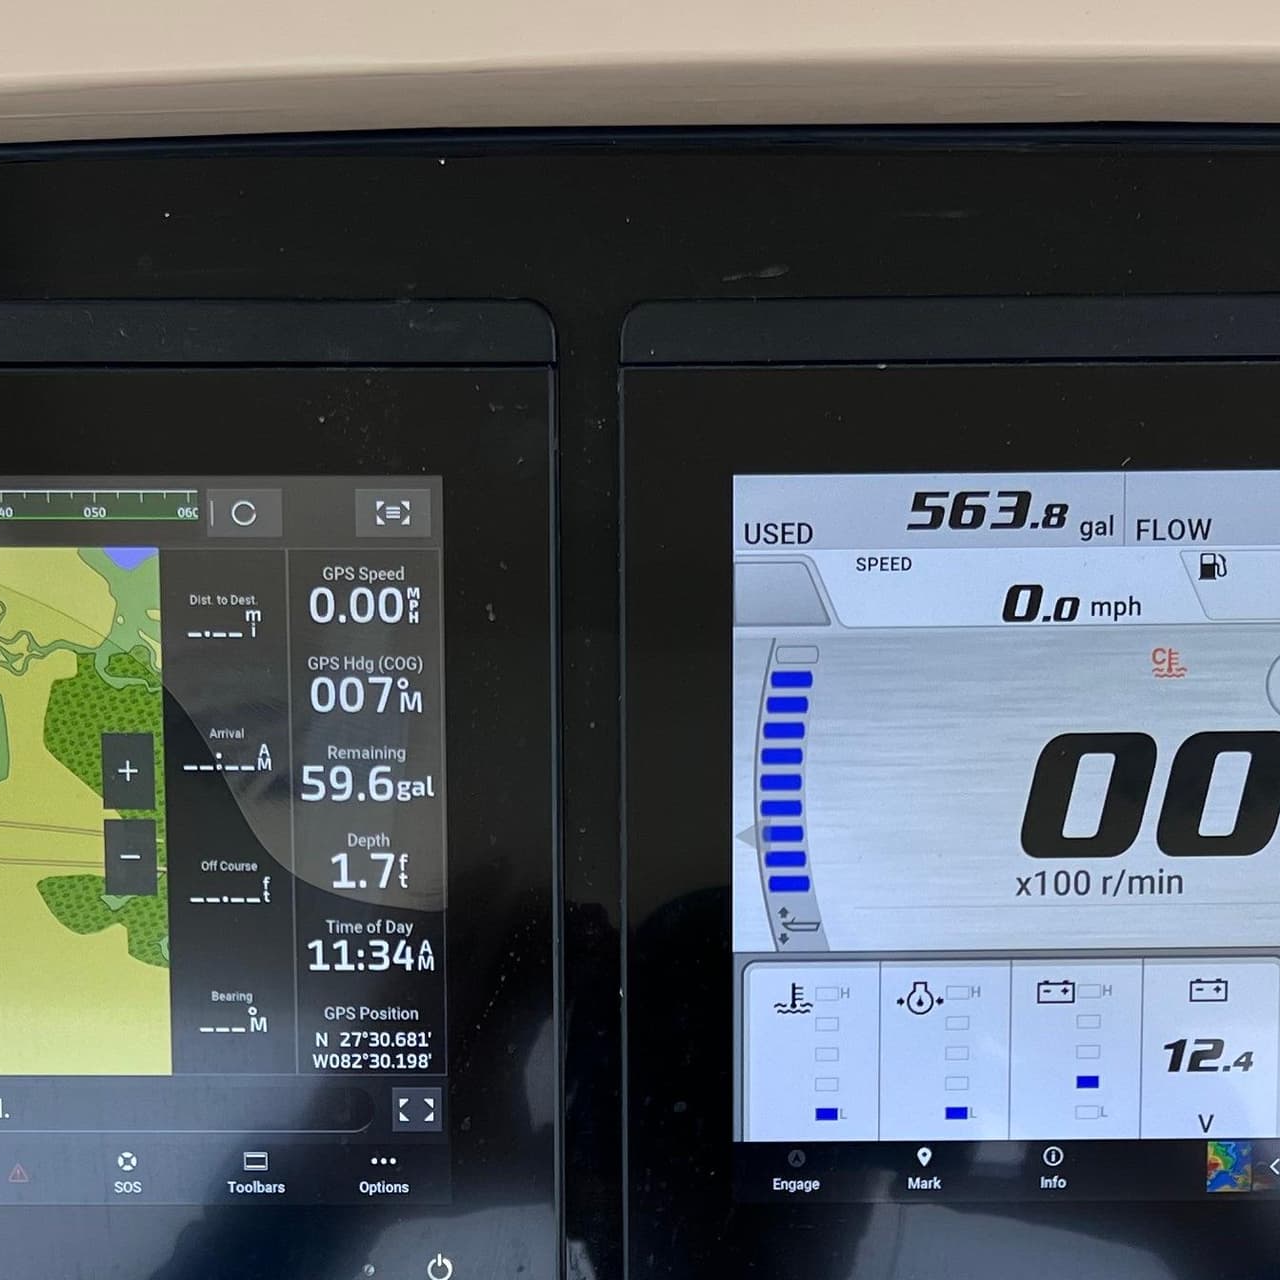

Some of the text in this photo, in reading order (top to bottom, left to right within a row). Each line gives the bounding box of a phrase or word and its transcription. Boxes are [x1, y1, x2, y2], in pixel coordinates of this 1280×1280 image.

[83, 508, 106, 518] 050
[906, 490, 1114, 541] 563.8 gal
[744, 522, 814, 546] USED
[1136, 518, 1212, 541] FLOW
[855, 556, 912, 572] SPEED
[323, 566, 405, 584] GPS Speed
[190, 594, 258, 606] Dist. to Dest.
[309, 586, 404, 624] 0.00
[1001, 583, 1142, 623] 0.0 mph
[307, 655, 423, 674] GPS Hdg (COG)
[209, 727, 244, 740] Arrival
[328, 745, 406, 763] Remaining
[348, 833, 390, 850] Depth
[201, 860, 258, 872] Off Course
[331, 853, 395, 889] 1.7
[1016, 867, 1184, 897] x100 r/min
[326, 919, 413, 936] Time of Day
[308, 939, 414, 972] 11:34
[211, 990, 253, 1004] Bearing
[324, 1006, 419, 1021] GPS Position
[316, 1032, 327, 1047] N
[1163, 1038, 1254, 1073] 12.4
[1198, 1114, 1214, 1134] V
[114, 1181, 141, 1194] SOS
[227, 1180, 285, 1194] Toolbars
[359, 1180, 409, 1198] Options
[772, 1177, 820, 1192] Engage
[907, 1175, 941, 1190] Mark
[1040, 1174, 1066, 1189] Info
